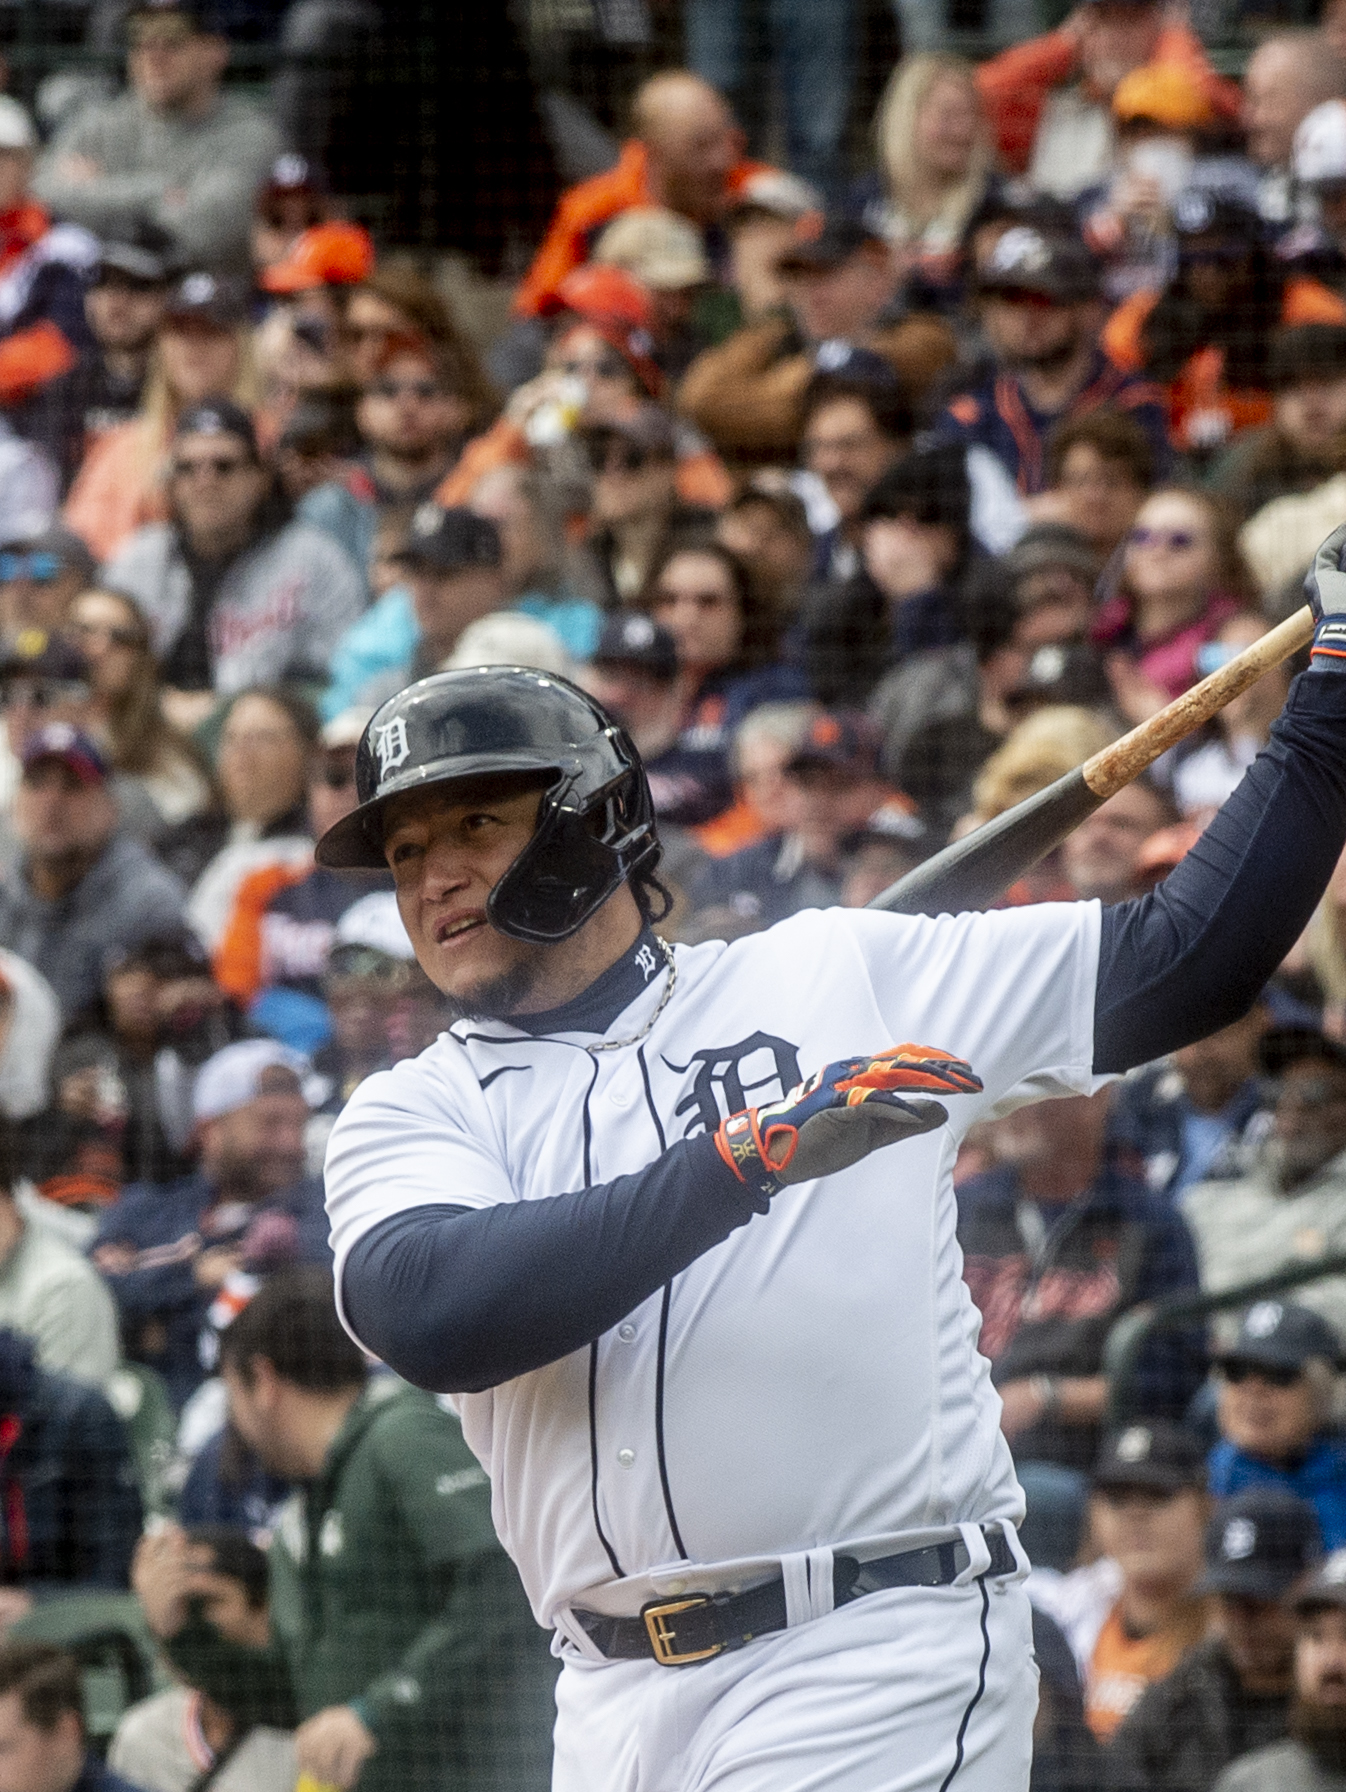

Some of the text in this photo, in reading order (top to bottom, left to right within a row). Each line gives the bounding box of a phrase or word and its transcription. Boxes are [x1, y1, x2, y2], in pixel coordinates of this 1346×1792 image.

[375, 716, 410, 782] D
[635, 944, 656, 982] D
[660, 1030, 804, 1138] D
